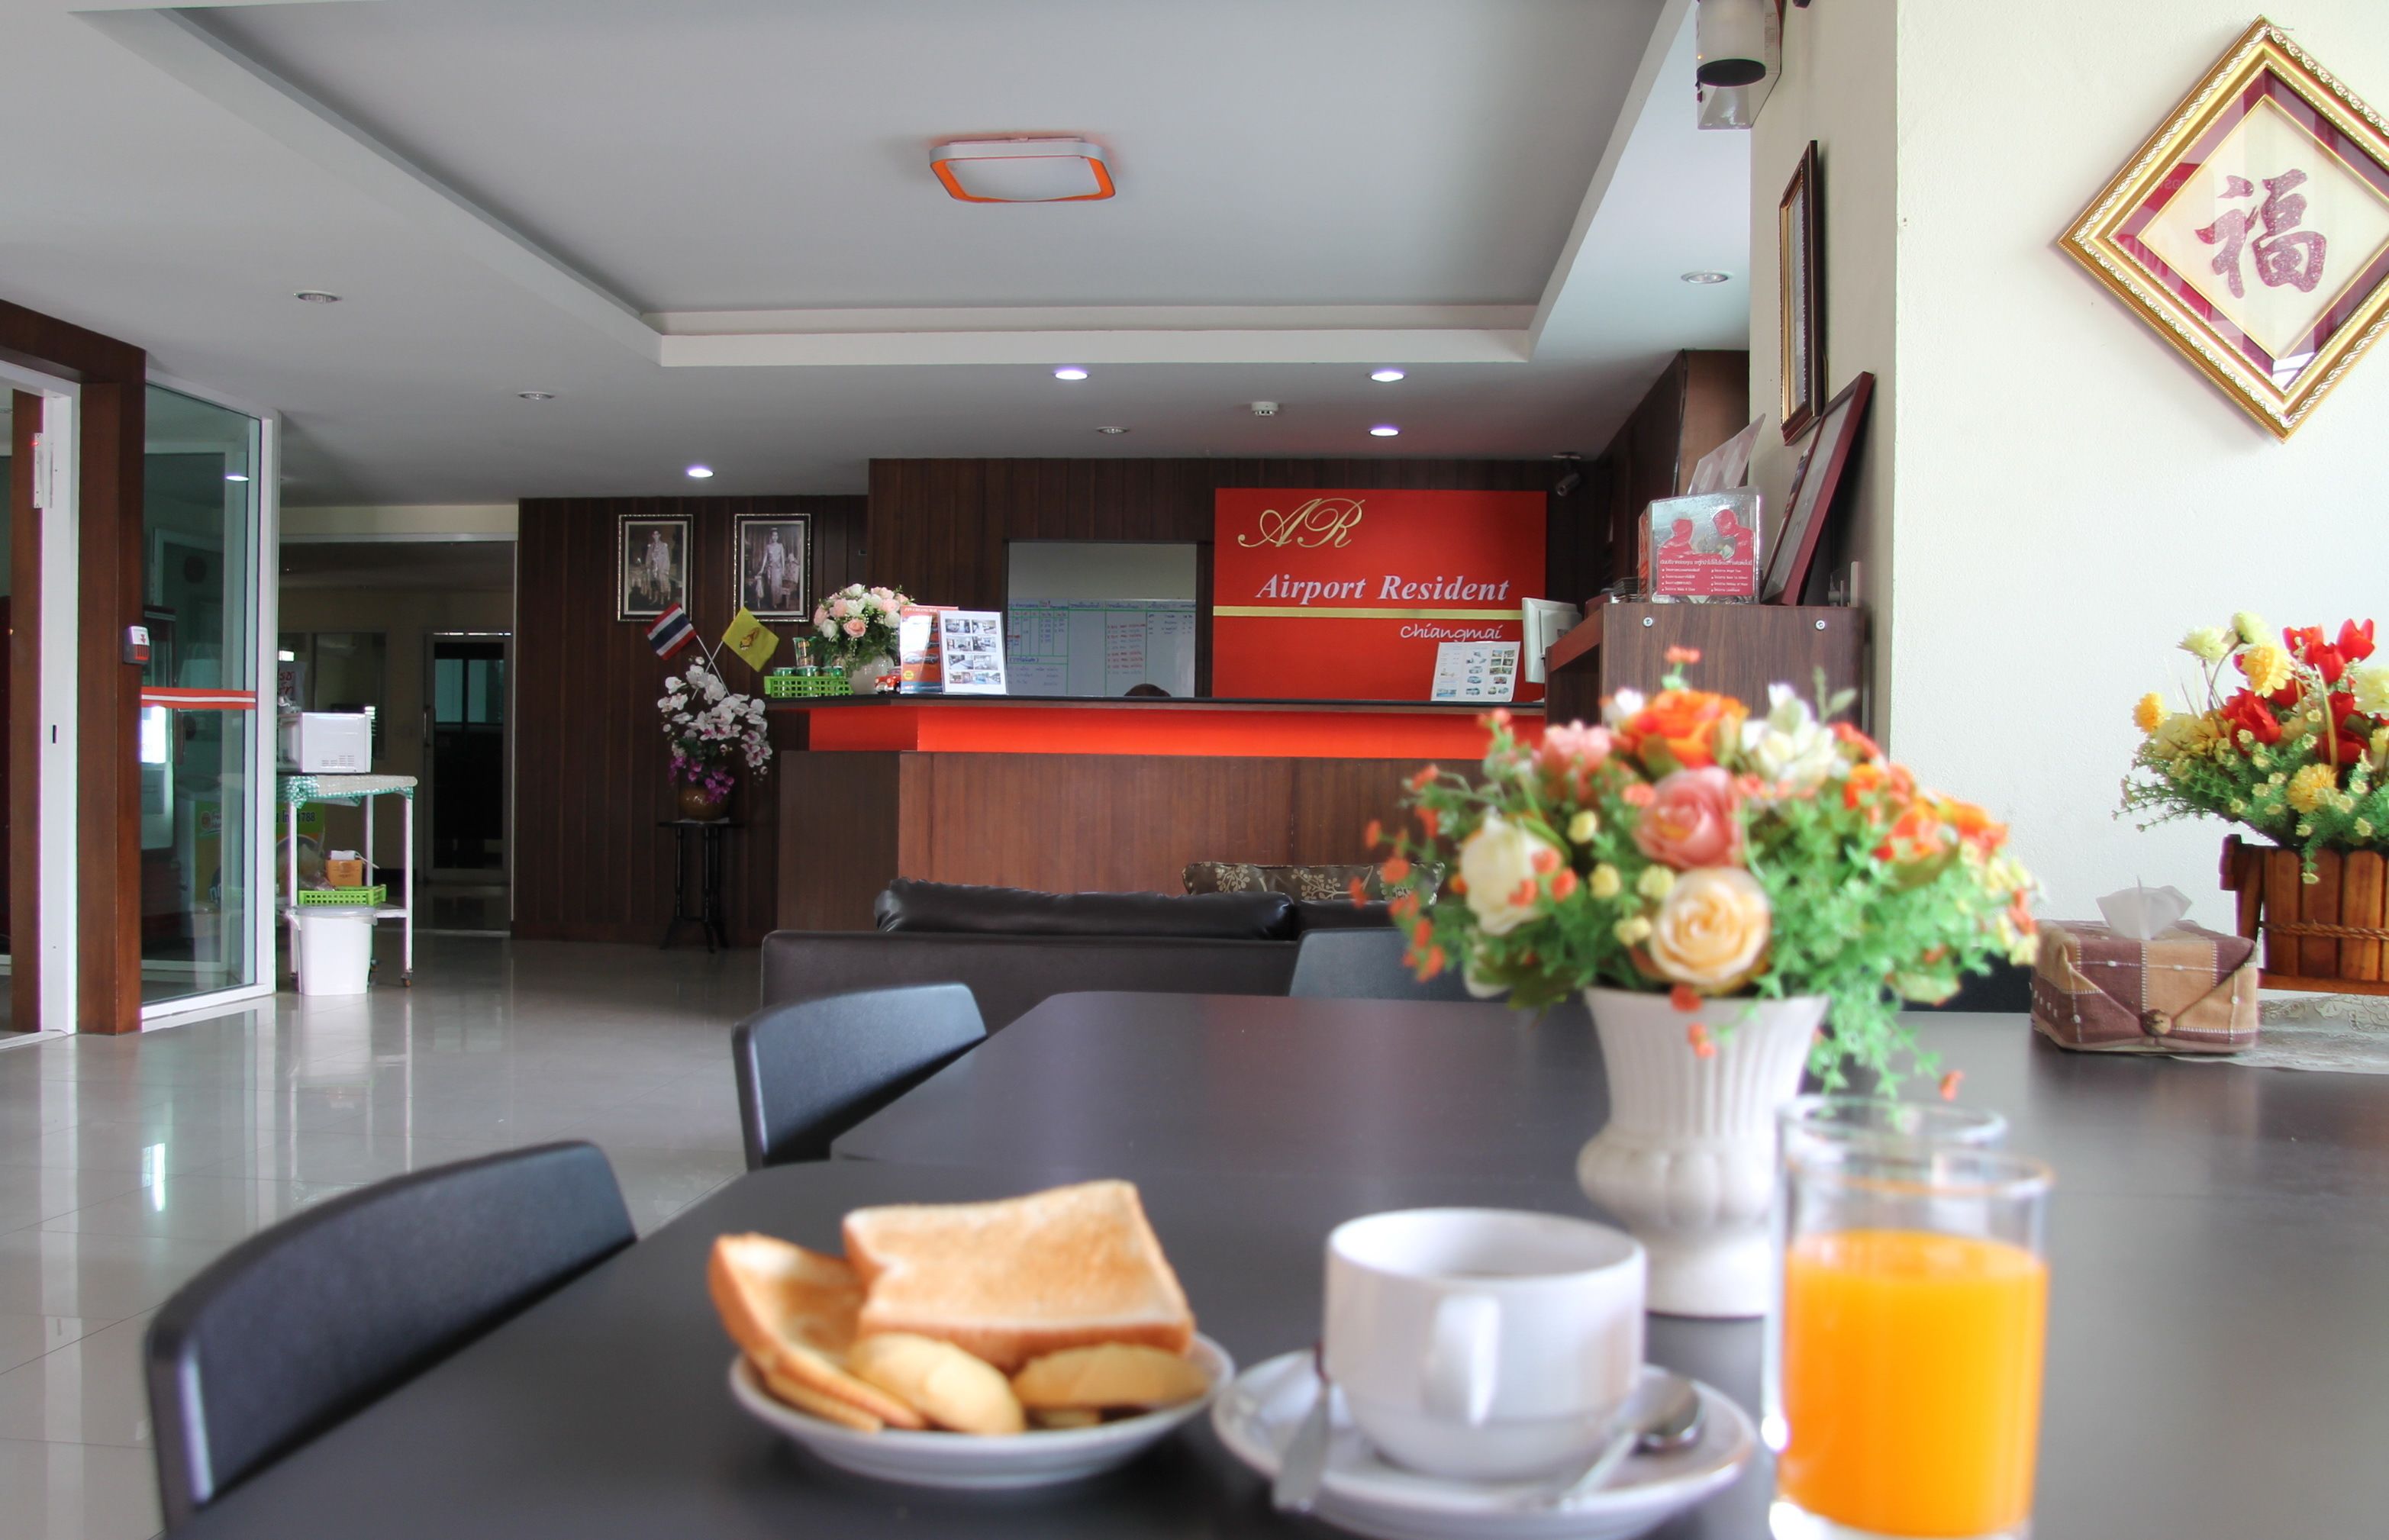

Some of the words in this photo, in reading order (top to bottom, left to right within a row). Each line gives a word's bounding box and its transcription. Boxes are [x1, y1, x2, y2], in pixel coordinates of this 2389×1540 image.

[2194, 168, 2327, 299] 福
[1237, 498, 1365, 548] AR
[1254, 574, 1366, 605] Airport
[1377, 575, 1510, 601] Resident
